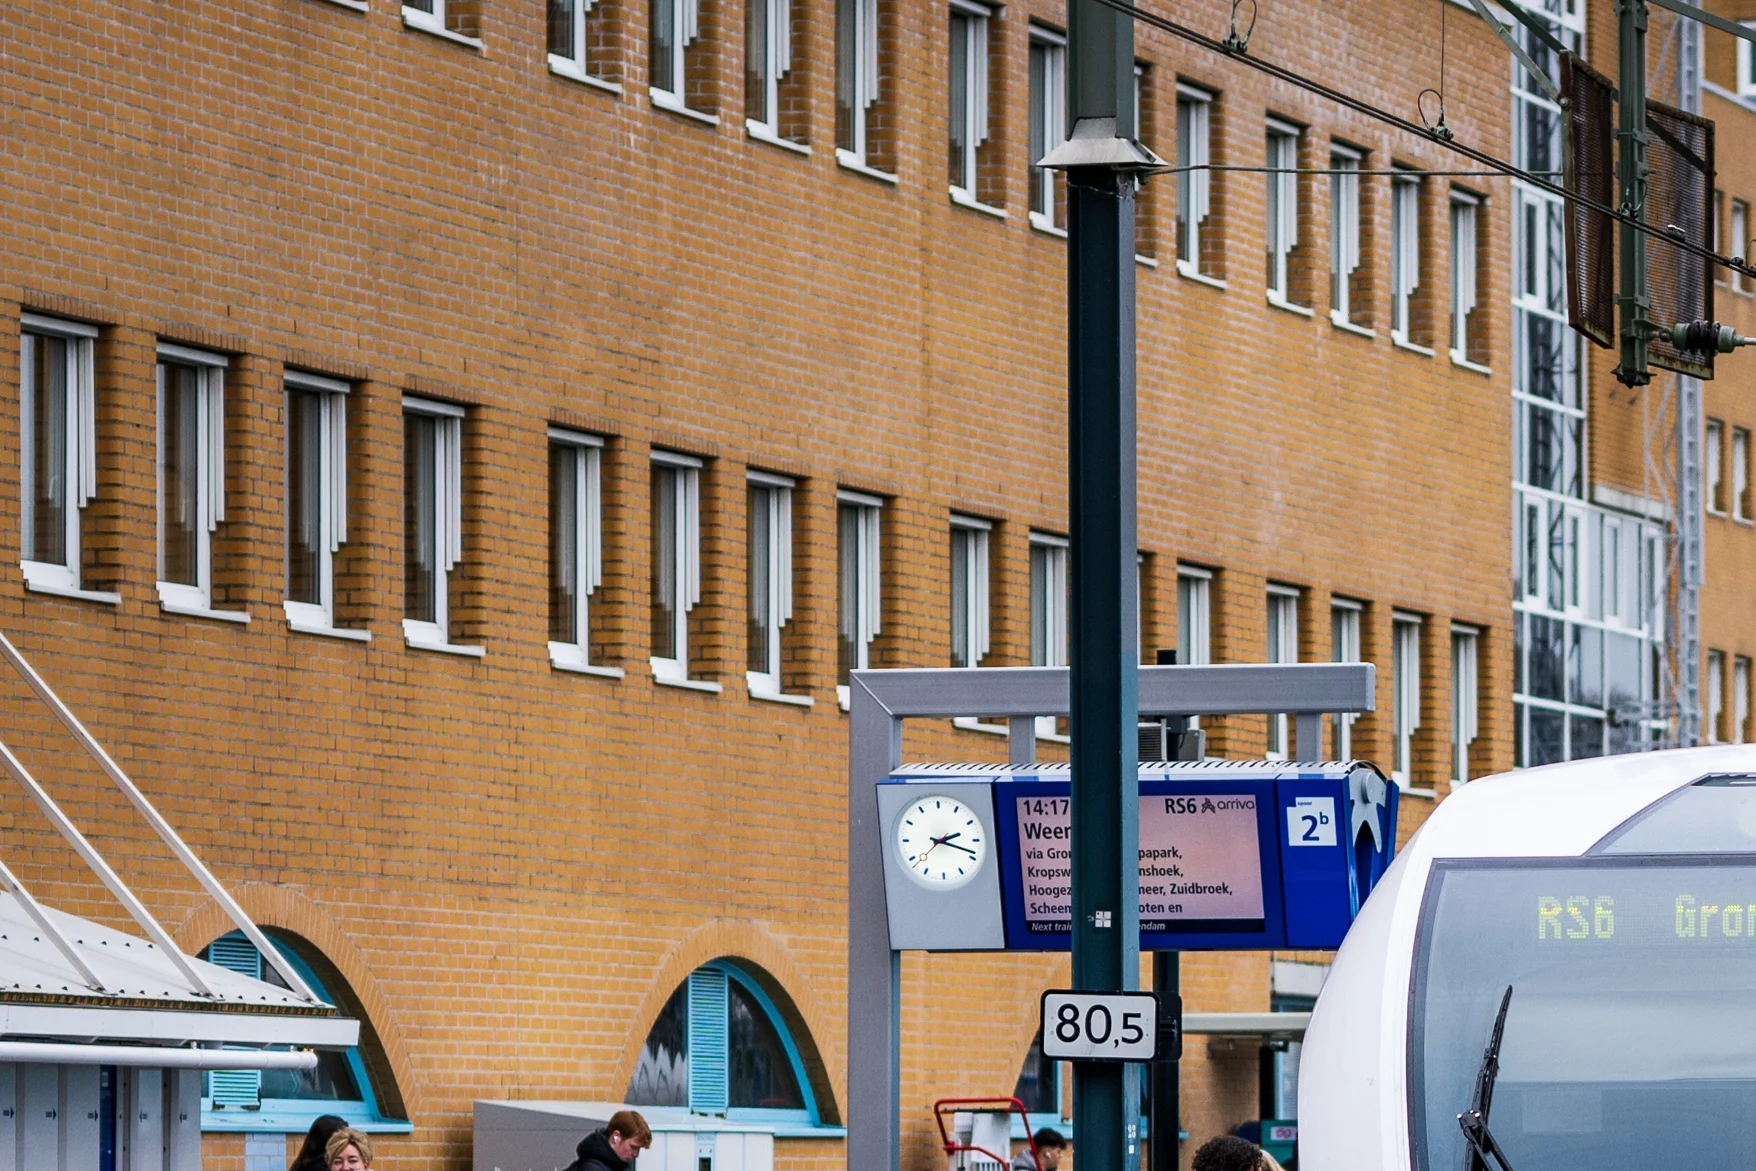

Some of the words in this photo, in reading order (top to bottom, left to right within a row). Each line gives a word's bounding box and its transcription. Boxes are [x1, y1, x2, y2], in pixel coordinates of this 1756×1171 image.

[1023, 799, 1069, 816] 14:17
[1165, 798, 1197, 815] RS6
[1216, 798, 1255, 811] arriva
[1026, 847, 1043, 860] via
[1169, 881, 1233, 896] Zuidbroek,
[1168, 904, 1183, 914] en
[1537, 895, 1615, 940] RS6
[1031, 922, 1052, 932] Next
[1138, 921, 1166, 931] ndam
[1055, 1003, 1144, 1049] 80,5
